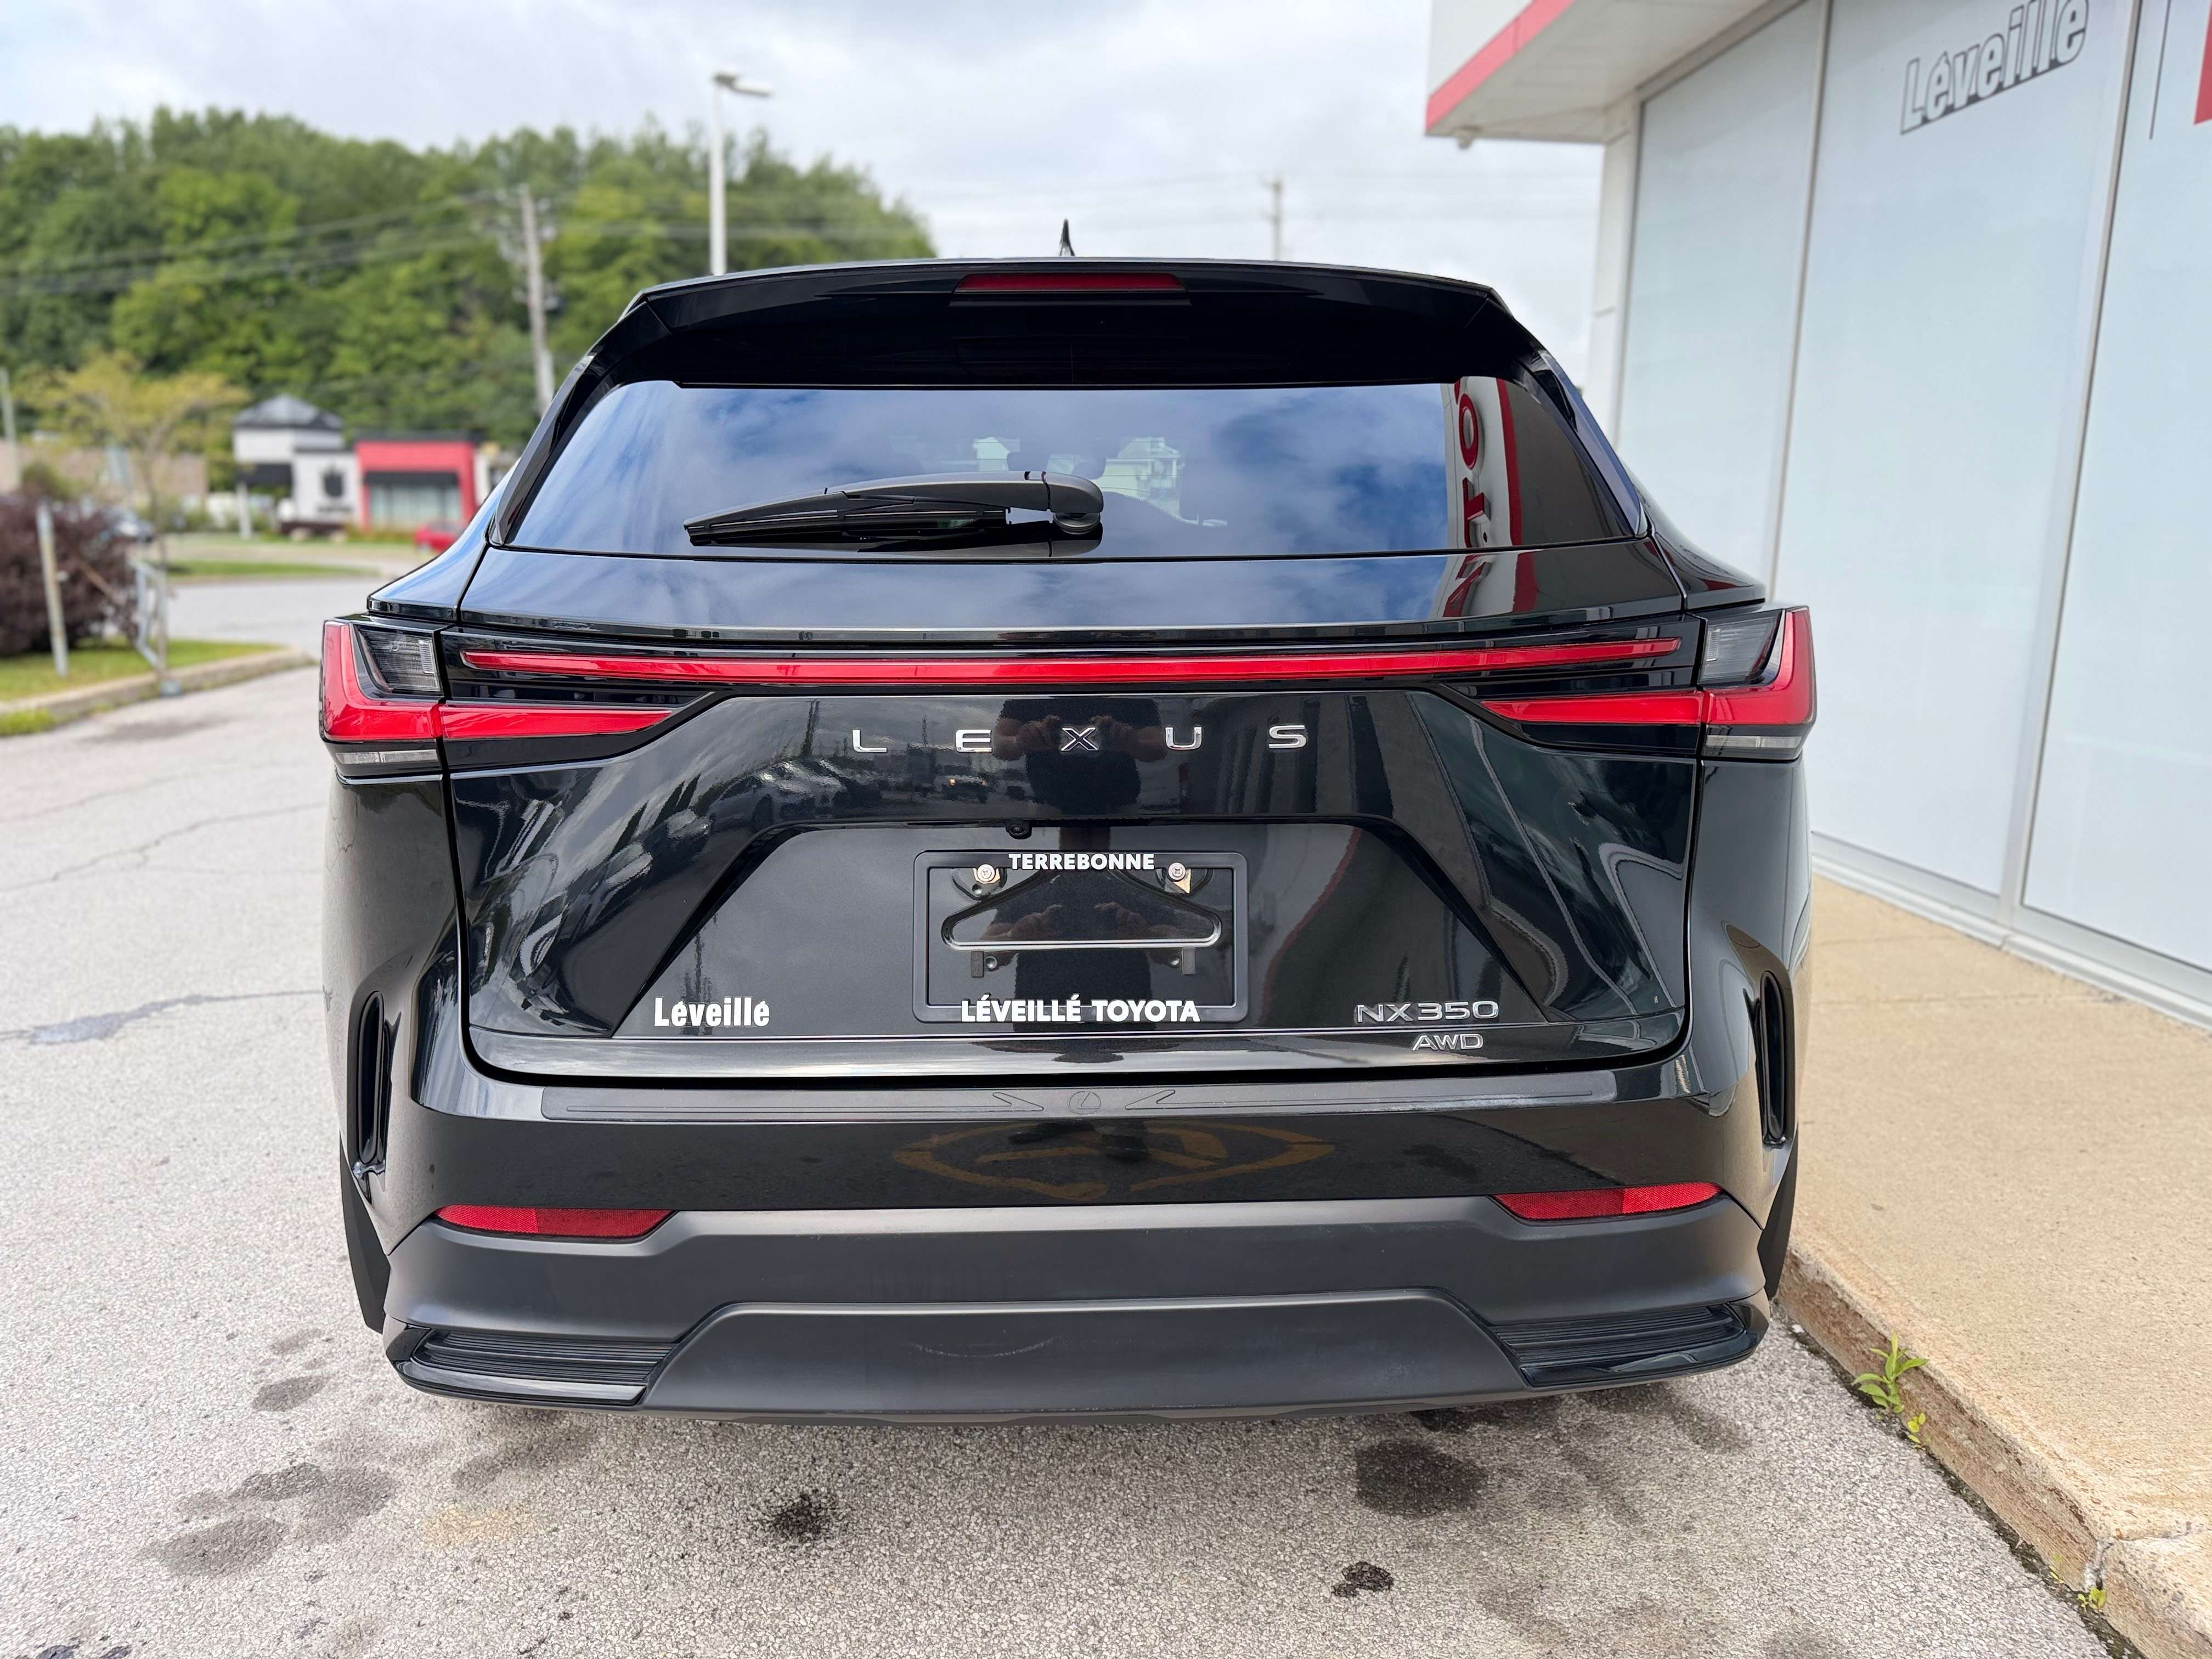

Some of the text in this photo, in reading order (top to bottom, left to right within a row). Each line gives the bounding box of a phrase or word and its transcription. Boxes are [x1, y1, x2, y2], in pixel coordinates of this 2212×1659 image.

[851, 725, 1307, 753] LEXUS
[1008, 853, 1155, 870] TERREBONNE
[654, 997, 770, 1026] Léveillé
[961, 994, 1200, 1022] LÉVEILLÉ TOYOTA
[1412, 1033, 1483, 1051] AWD
